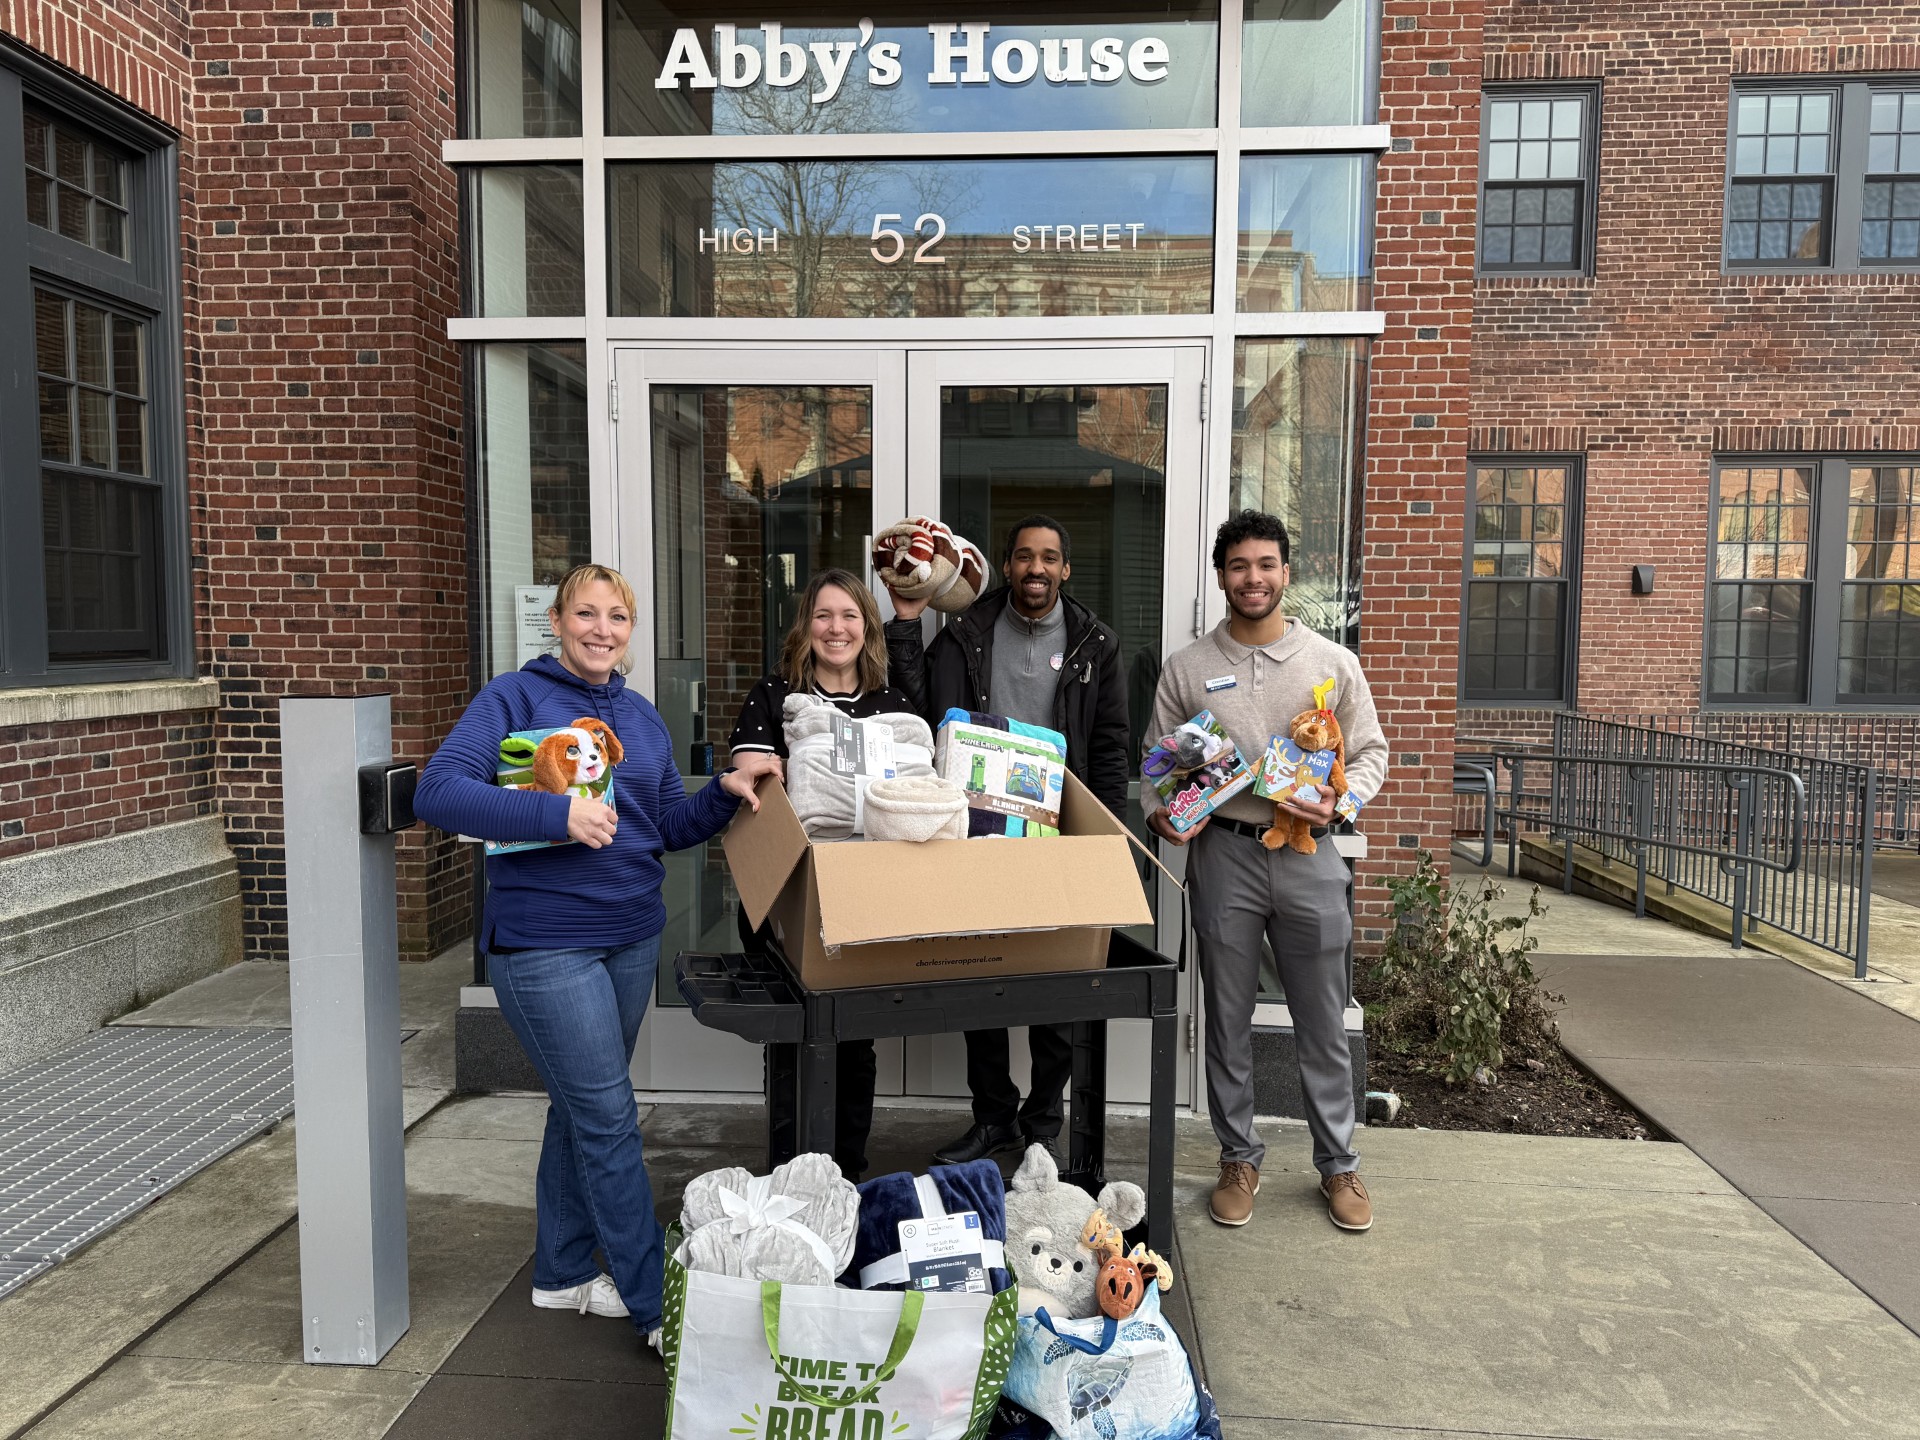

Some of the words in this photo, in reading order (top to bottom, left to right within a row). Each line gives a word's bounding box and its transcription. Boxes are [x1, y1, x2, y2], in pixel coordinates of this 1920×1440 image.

[654, 16, 902, 103] Abby's
[927, 22, 1170, 84] House
[699, 227, 779, 255] HIGH
[869, 212, 947, 264] 52
[1012, 222, 1145, 254] STREET
[960, 737, 1005, 753] MINECRAFT
[1307, 755, 1329, 769] Max
[992, 798, 1025, 813] BLANKET
[915, 955, 1003, 967] charlesriverapparel.com
[770, 1354, 848, 1381] TIME
[855, 1363, 896, 1382] TO
[764, 1406, 885, 1440] BREAD
